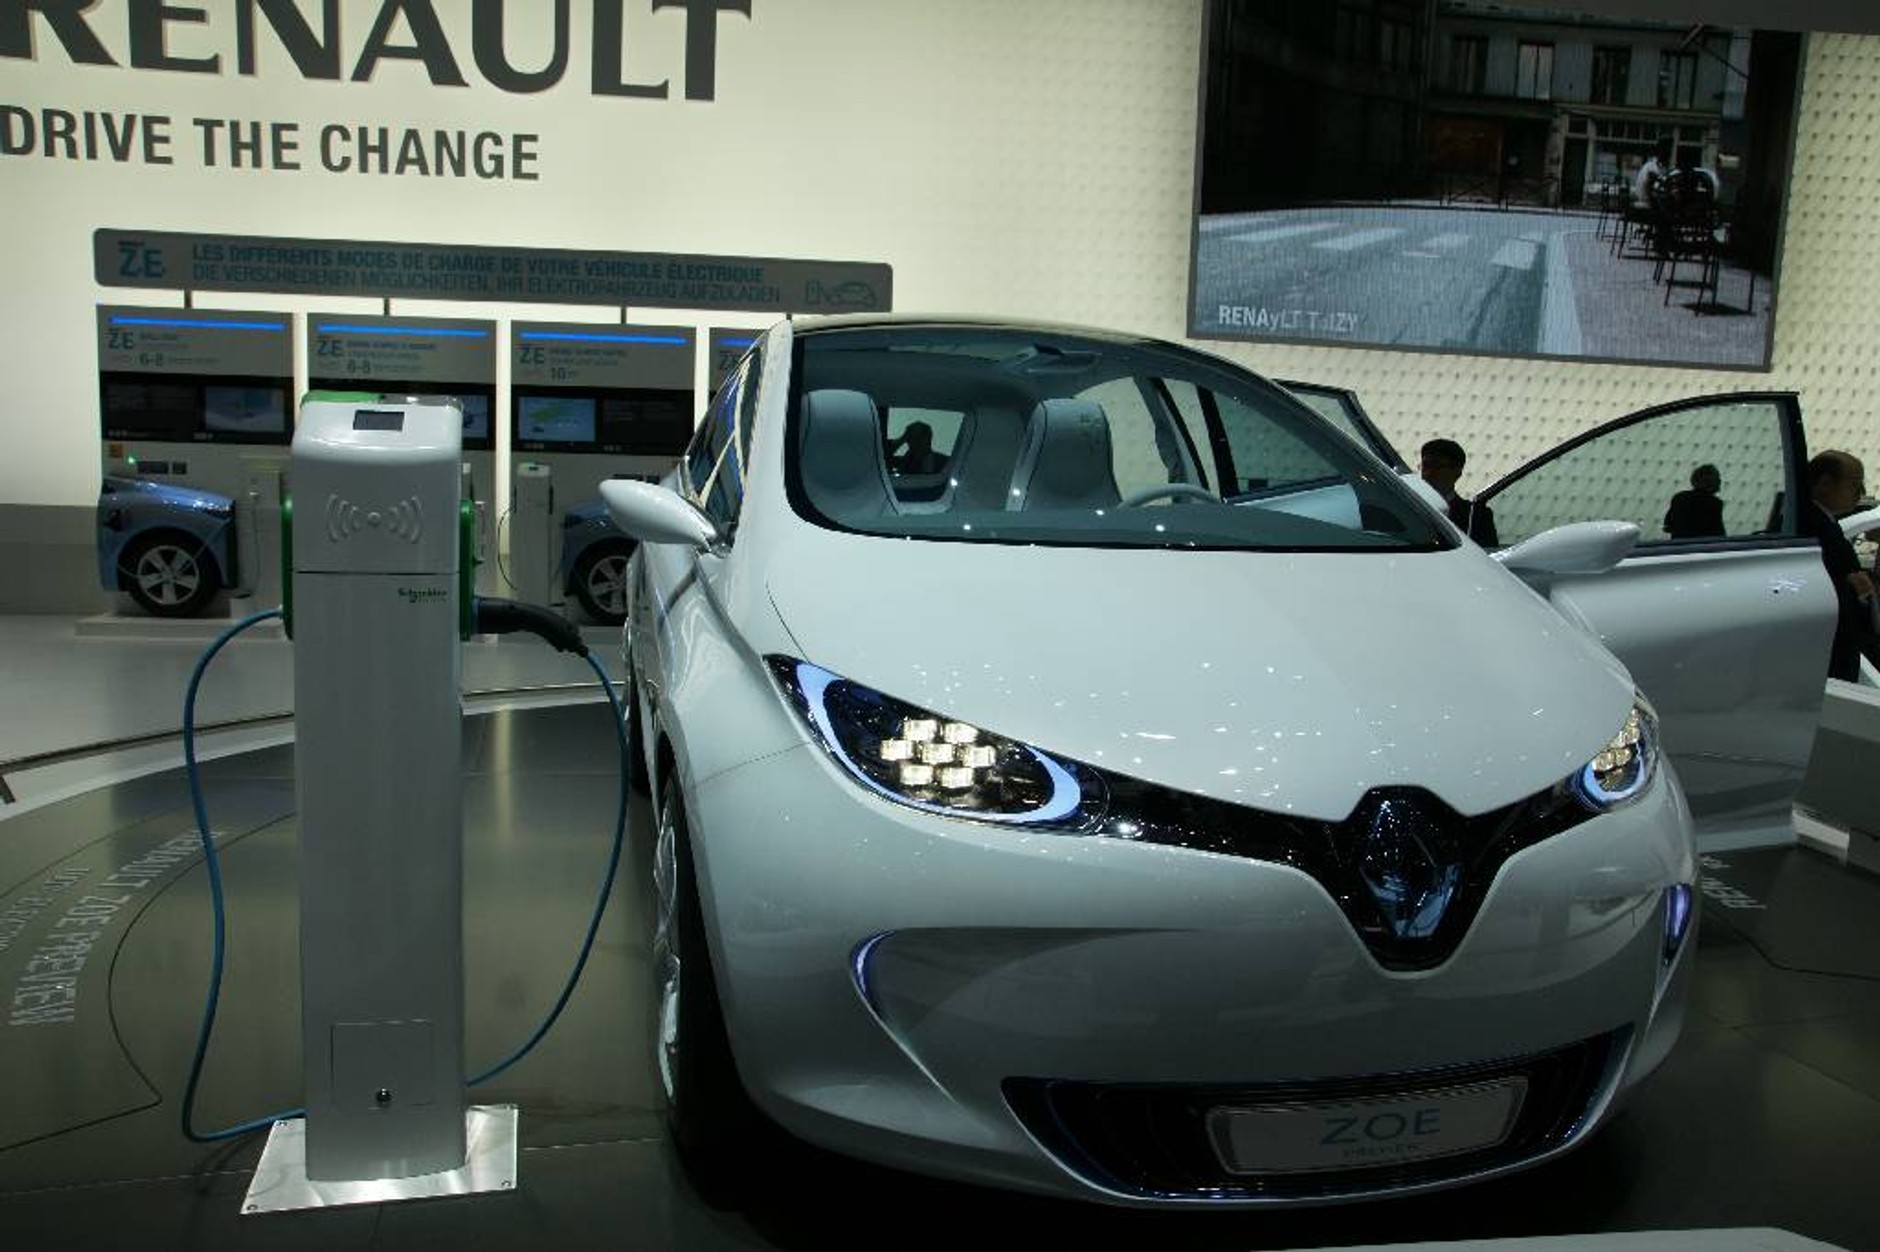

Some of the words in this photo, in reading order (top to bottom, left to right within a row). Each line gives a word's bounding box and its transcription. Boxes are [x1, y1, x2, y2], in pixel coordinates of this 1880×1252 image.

[0, 104, 173, 167] DRIVE
[192, 117, 300, 170] THE
[319, 124, 539, 181] CHANGE
[192, 245, 223, 262] LES
[337, 250, 396, 269] MODES
[401, 253, 422, 271] DE
[1319, 1107, 1441, 1146] ZOE
